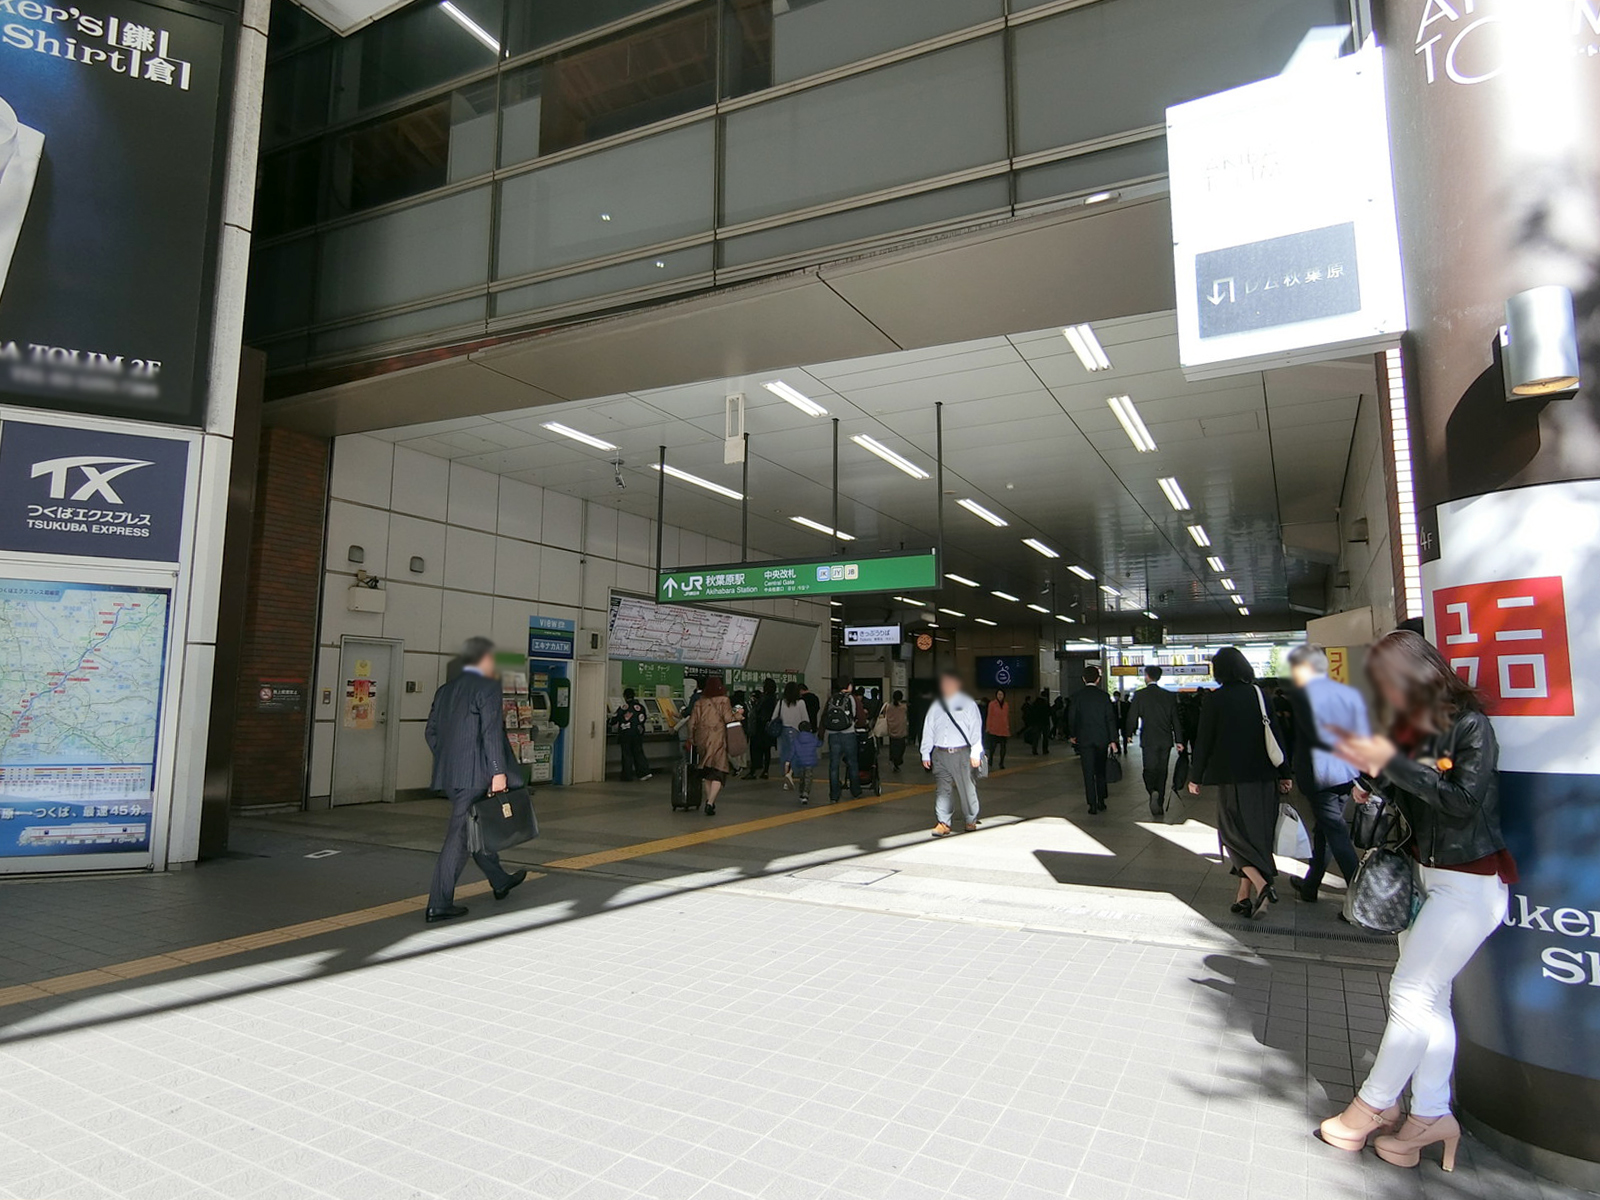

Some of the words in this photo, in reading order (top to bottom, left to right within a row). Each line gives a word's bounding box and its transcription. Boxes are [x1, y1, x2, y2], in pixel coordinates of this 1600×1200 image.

[30, 456, 156, 504] TX
[27, 505, 151, 525] つくばエクスプレス
[27, 519, 88, 533] TSUKUBA
[92, 525, 150, 537] EXPRESS
[705, 573, 745, 587] 秋葉原駅
[764, 568, 797, 579] 中央改札
[681, 576, 703, 591] JR
[705, 587, 735, 596] Akihabara
[736, 585, 758, 594] Station
[534, 641, 569, 651] エキナカATM
